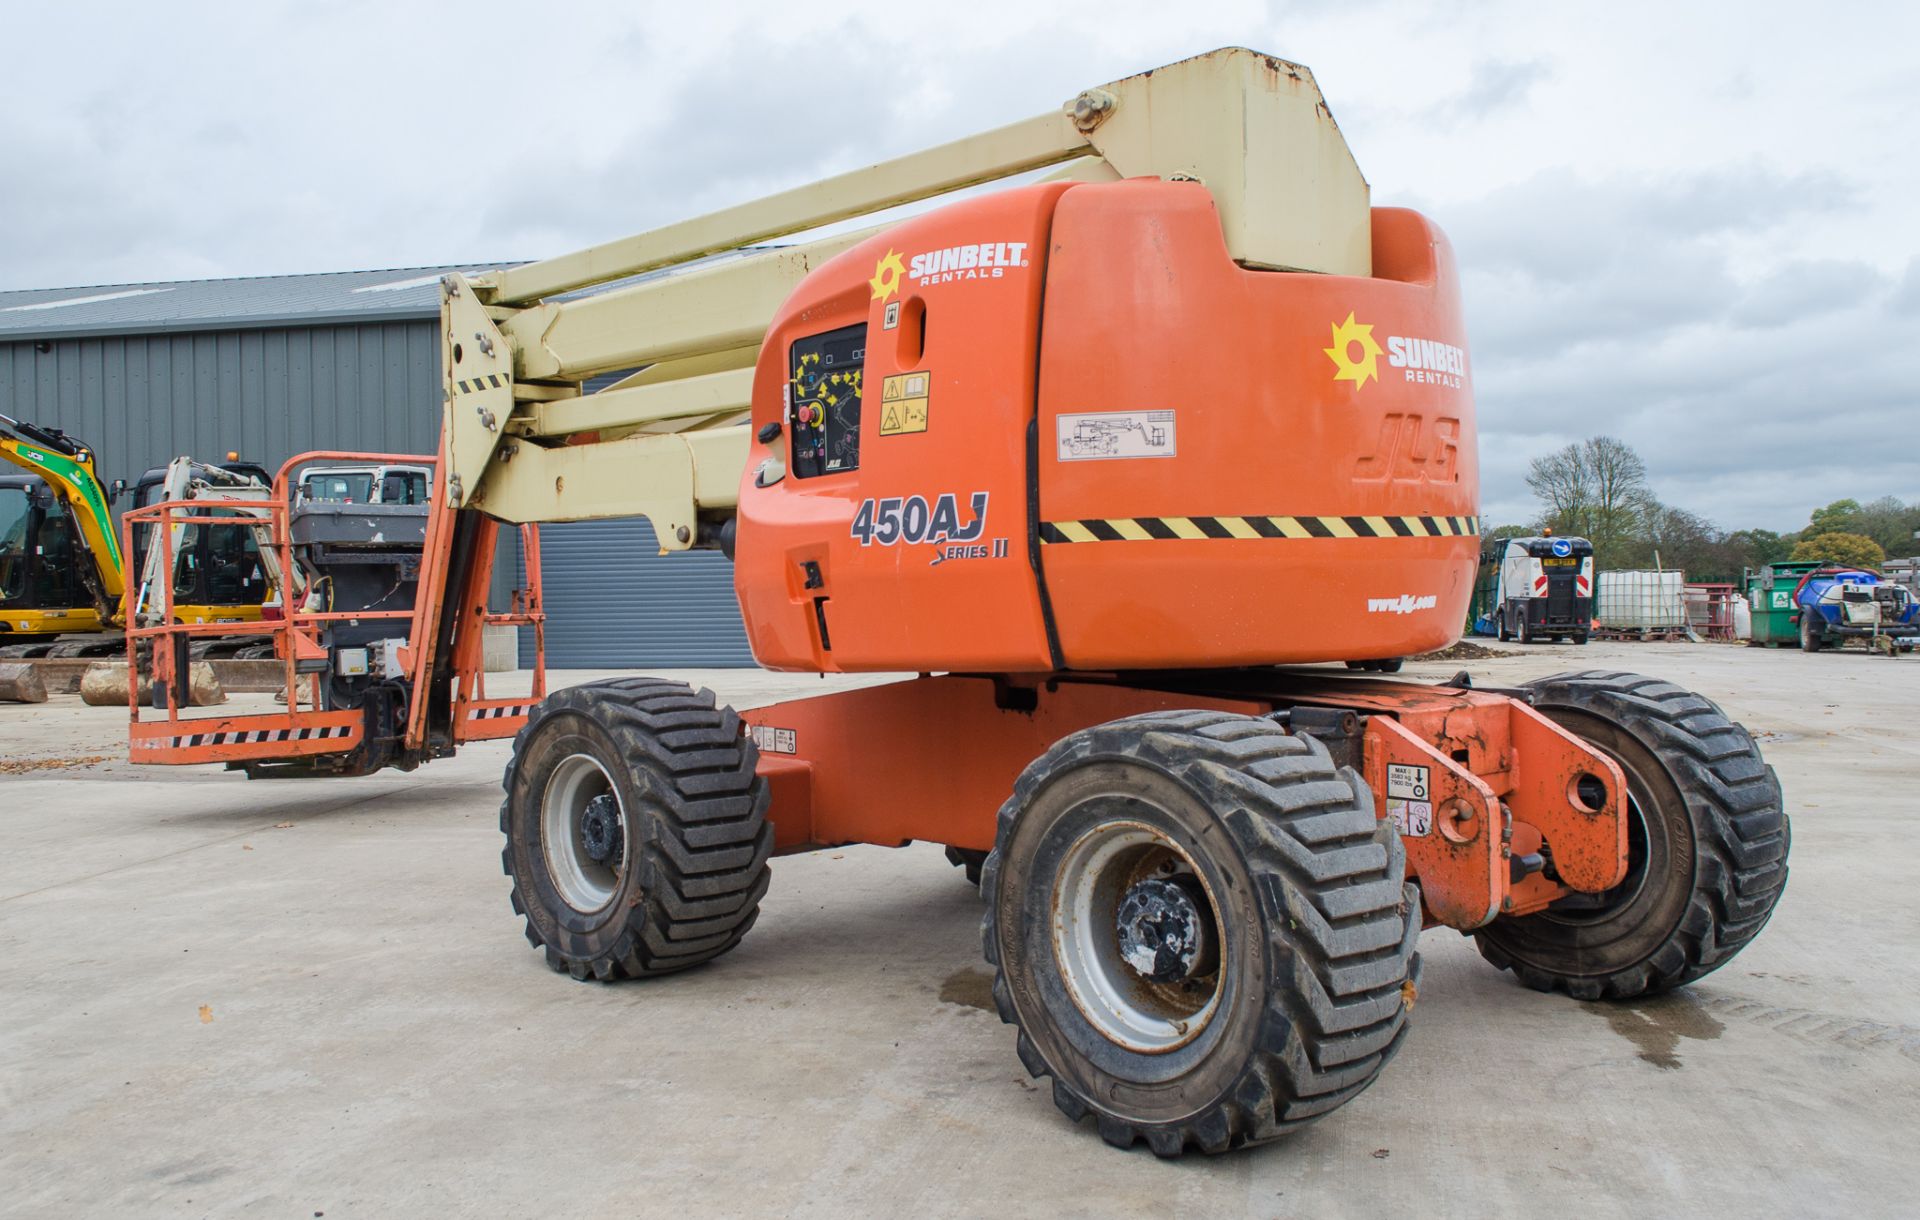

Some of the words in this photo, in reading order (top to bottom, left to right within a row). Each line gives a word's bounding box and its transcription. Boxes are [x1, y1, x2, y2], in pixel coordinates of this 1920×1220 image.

[908, 242, 1028, 279] SUNBELT
[920, 267, 1004, 287] RENTALS
[1387, 335, 1464, 377] SUNBELT
[1405, 369, 1462, 389] RENTALS
[1351, 412, 1461, 486] JLG
[850, 491, 989, 547] 450AJ
[929, 537, 988, 566] SERIES
